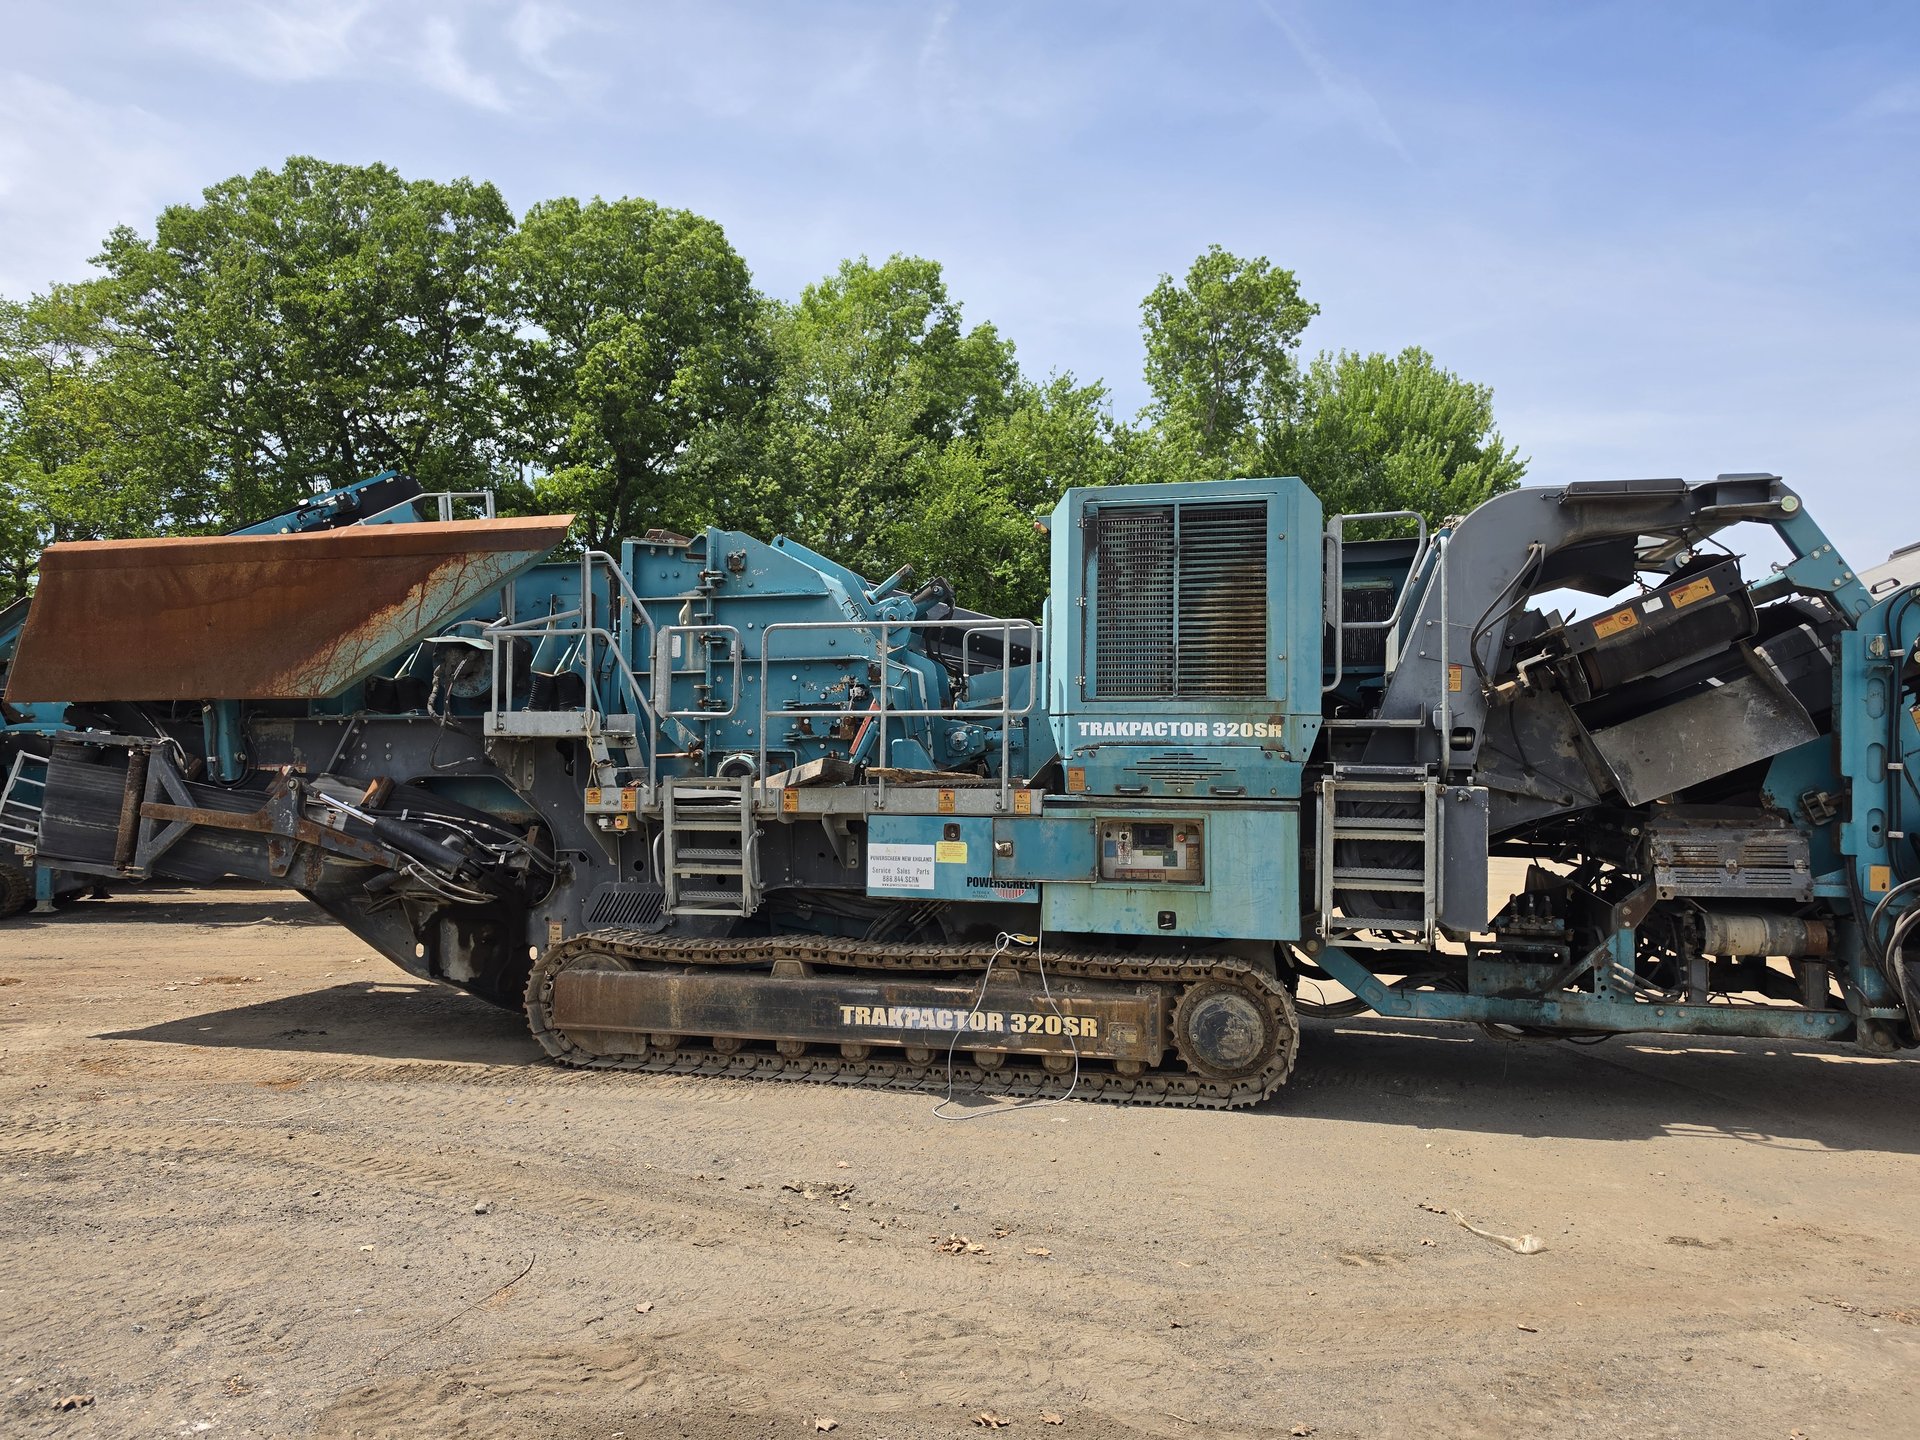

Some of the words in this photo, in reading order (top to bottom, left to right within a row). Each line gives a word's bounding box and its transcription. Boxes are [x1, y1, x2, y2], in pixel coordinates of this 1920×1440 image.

[1077, 721, 1208, 737] TRAKPACTOR
[1212, 722, 1282, 738] 320SR
[872, 866, 891, 874] Service
[896, 867, 910, 875] Sales
[916, 867, 930, 875] Parts
[966, 876, 1036, 890] POWERSCREEN
[839, 1005, 1004, 1032] TRAKPACTOR
[1010, 1013, 1098, 1038] 320SR
